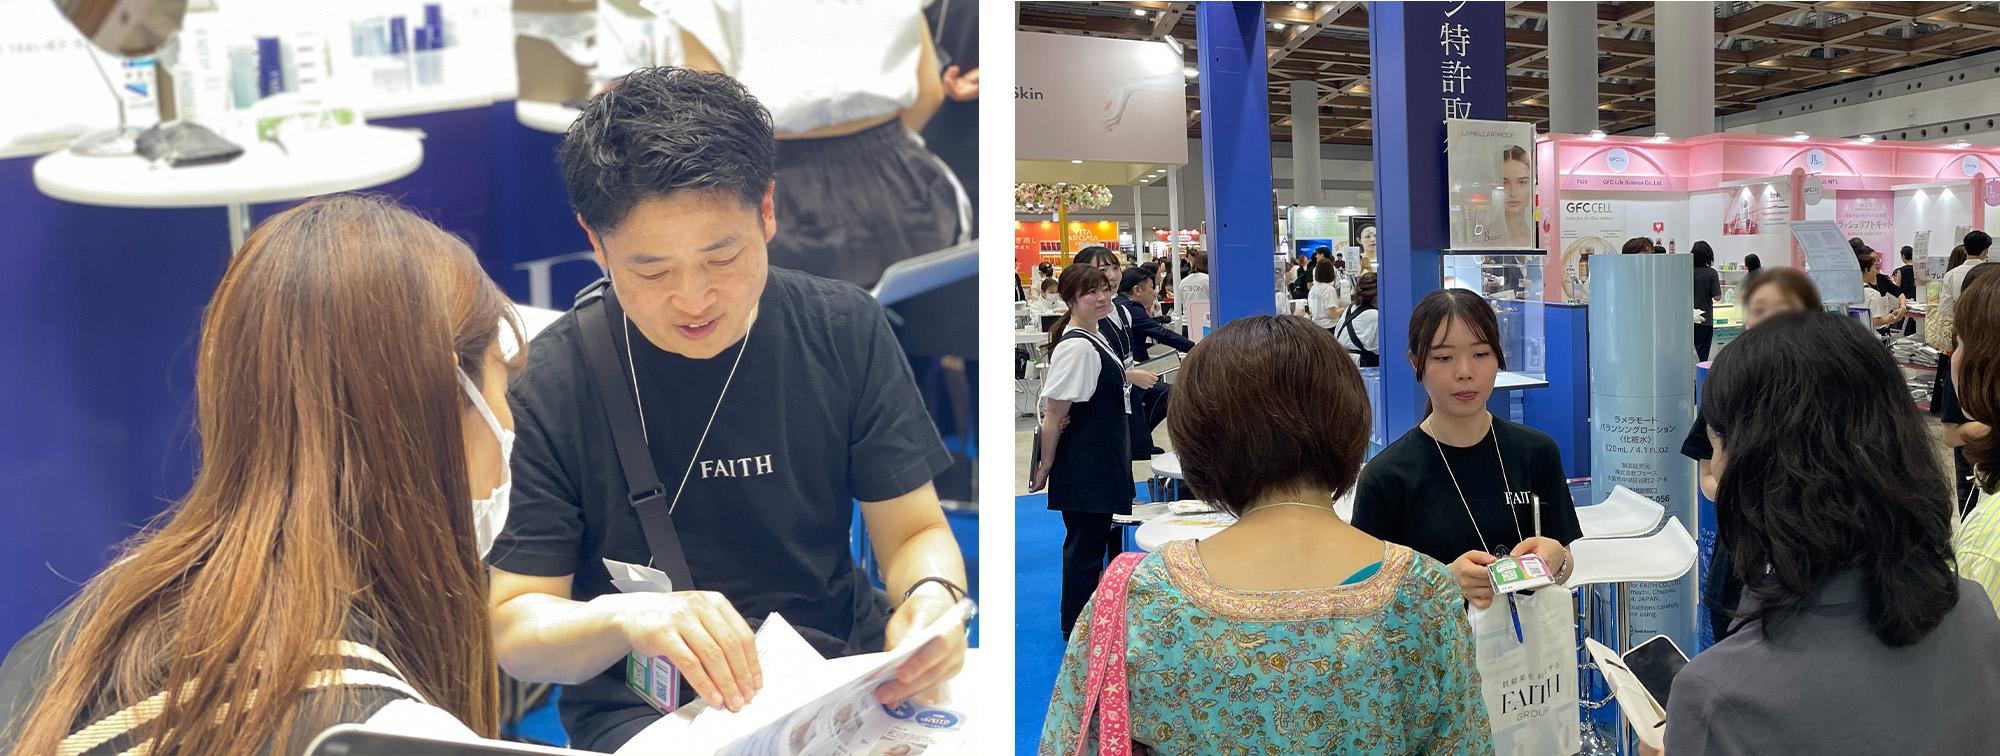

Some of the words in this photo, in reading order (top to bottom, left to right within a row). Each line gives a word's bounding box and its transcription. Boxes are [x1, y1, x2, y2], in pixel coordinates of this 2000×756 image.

[1439, 1, 1473, 154] ン特許取
[1461, 130, 1496, 138] LAMELLAR
[1624, 179, 1645, 187] Science
[1614, 415, 1658, 425] ラメラモード
[1600, 424, 1676, 434] バランシングローション
[699, 453, 774, 480] FAITH
[1501, 672, 1561, 716] FAITH
